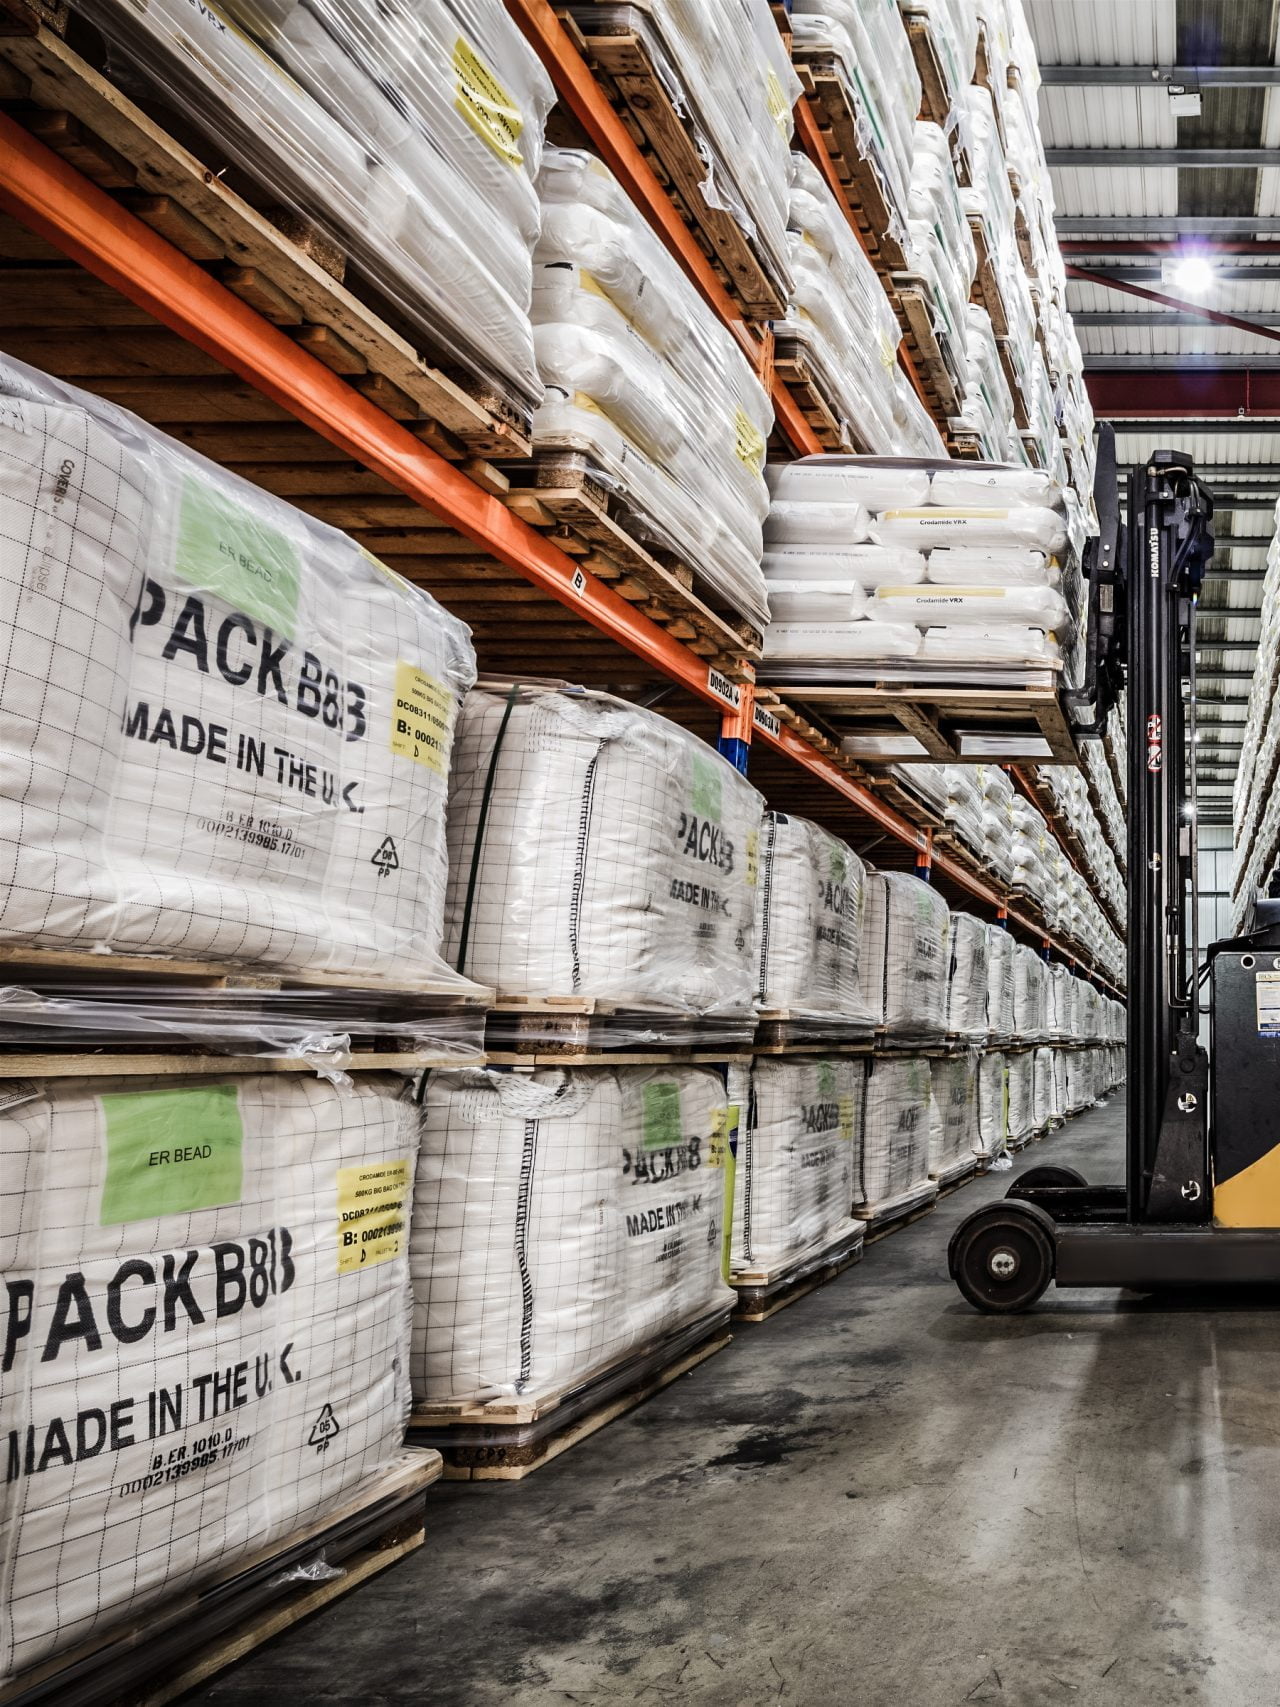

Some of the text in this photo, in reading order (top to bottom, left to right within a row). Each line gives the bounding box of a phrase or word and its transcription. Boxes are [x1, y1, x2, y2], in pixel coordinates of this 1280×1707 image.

[53, 459, 75, 506] COVERIS
[219, 541, 273, 584] ER BEAD
[1151, 527, 1159, 578] KOMATSU
[575, 572, 583, 589] B
[710, 672, 733, 702] D0902A
[397, 719, 411, 736] B:
[124, 701, 228, 764] MADE
[237, 734, 266, 777] IN
[273, 746, 318, 798] THE
[701, 886, 711, 909] IN
[148, 1145, 212, 1167] ER BEAD
[359, 1170, 386, 1181] CRODAMIDE
[355, 1188, 372, 1198] 500KG
[373, 1186, 382, 1195] BIG
[383, 1184, 393, 1193] BAG
[626, 1204, 676, 1237] MADE IN
[343, 1231, 358, 1247] B:
[2, 1250, 206, 1372] PACK
[7, 1397, 135, 1485] MADE
[149, 1383, 182, 1440] IN
[193, 1360, 249, 1422] THE
[319, 1419, 331, 1434] 05
[317, 1442, 329, 1455] PP
